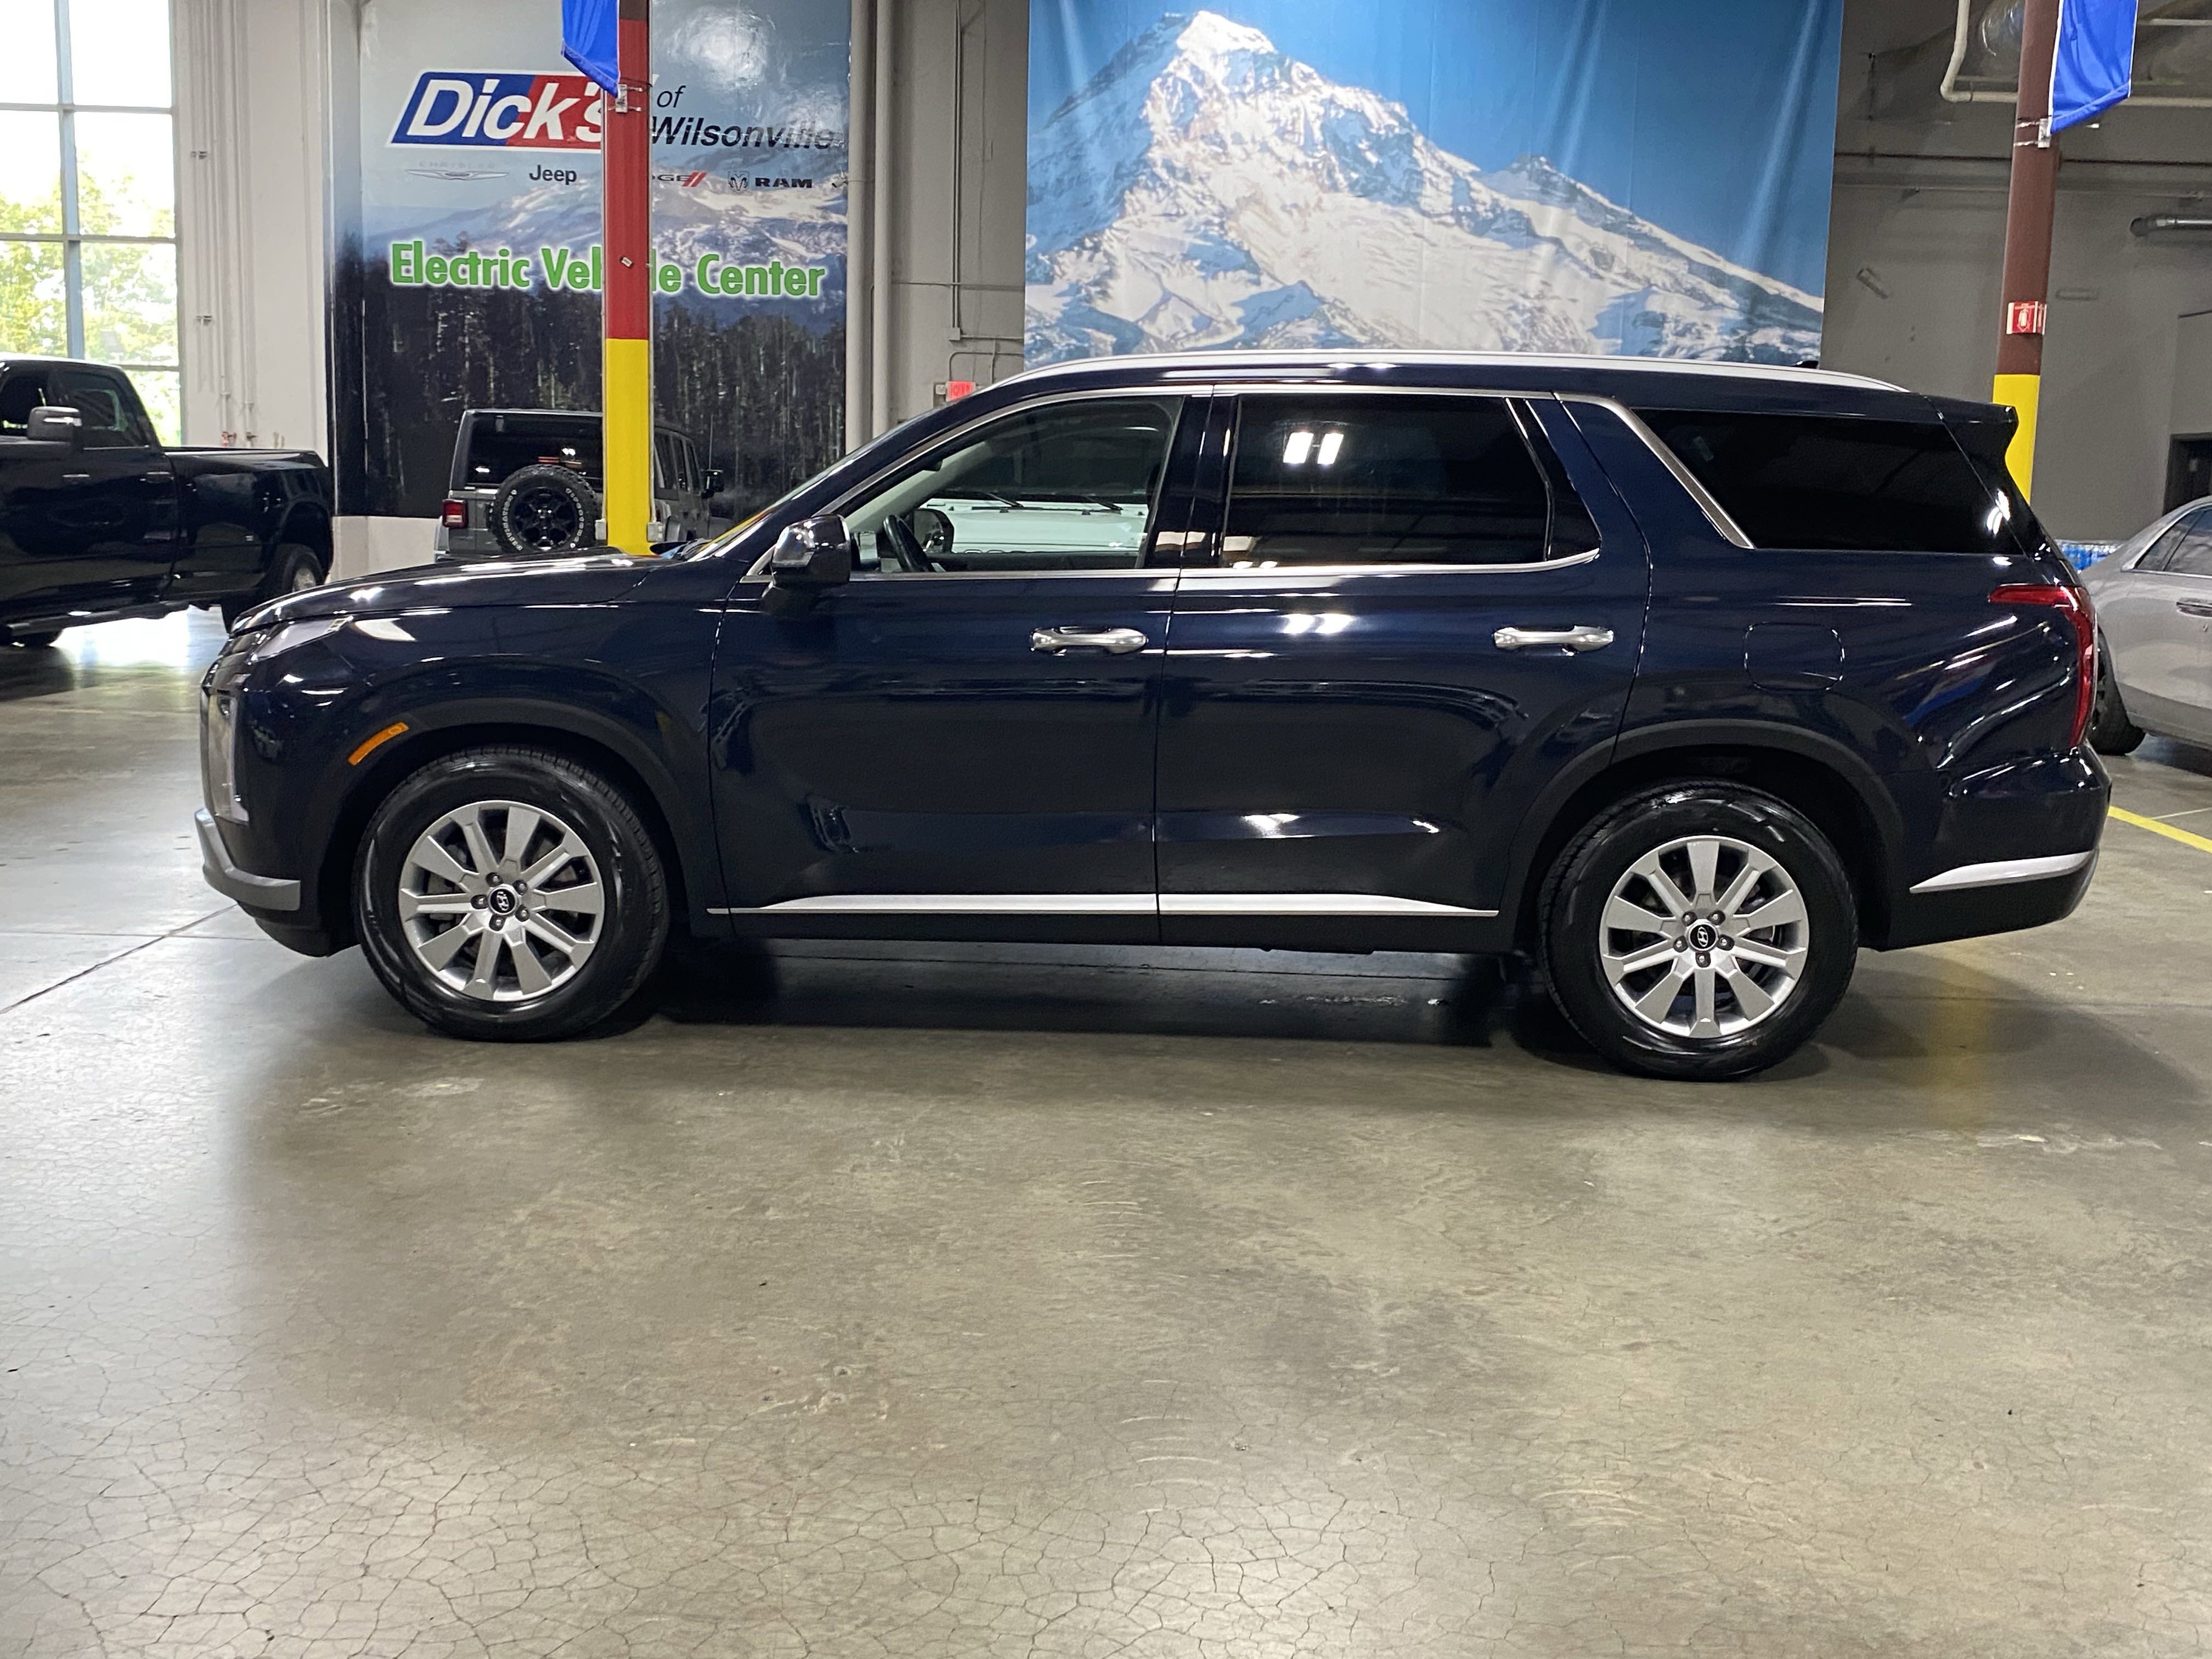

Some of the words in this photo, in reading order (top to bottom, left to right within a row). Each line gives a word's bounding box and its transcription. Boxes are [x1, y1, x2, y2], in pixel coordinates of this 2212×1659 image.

[407, 78, 602, 143] Dick's
[657, 85, 686, 108] of
[652, 116, 833, 149] Wilsonville
[529, 165, 577, 185] Jeep
[755, 177, 812, 189] RAM
[392, 241, 530, 287] Electric
[541, 246, 681, 292] Vele
[697, 253, 825, 296] Center
